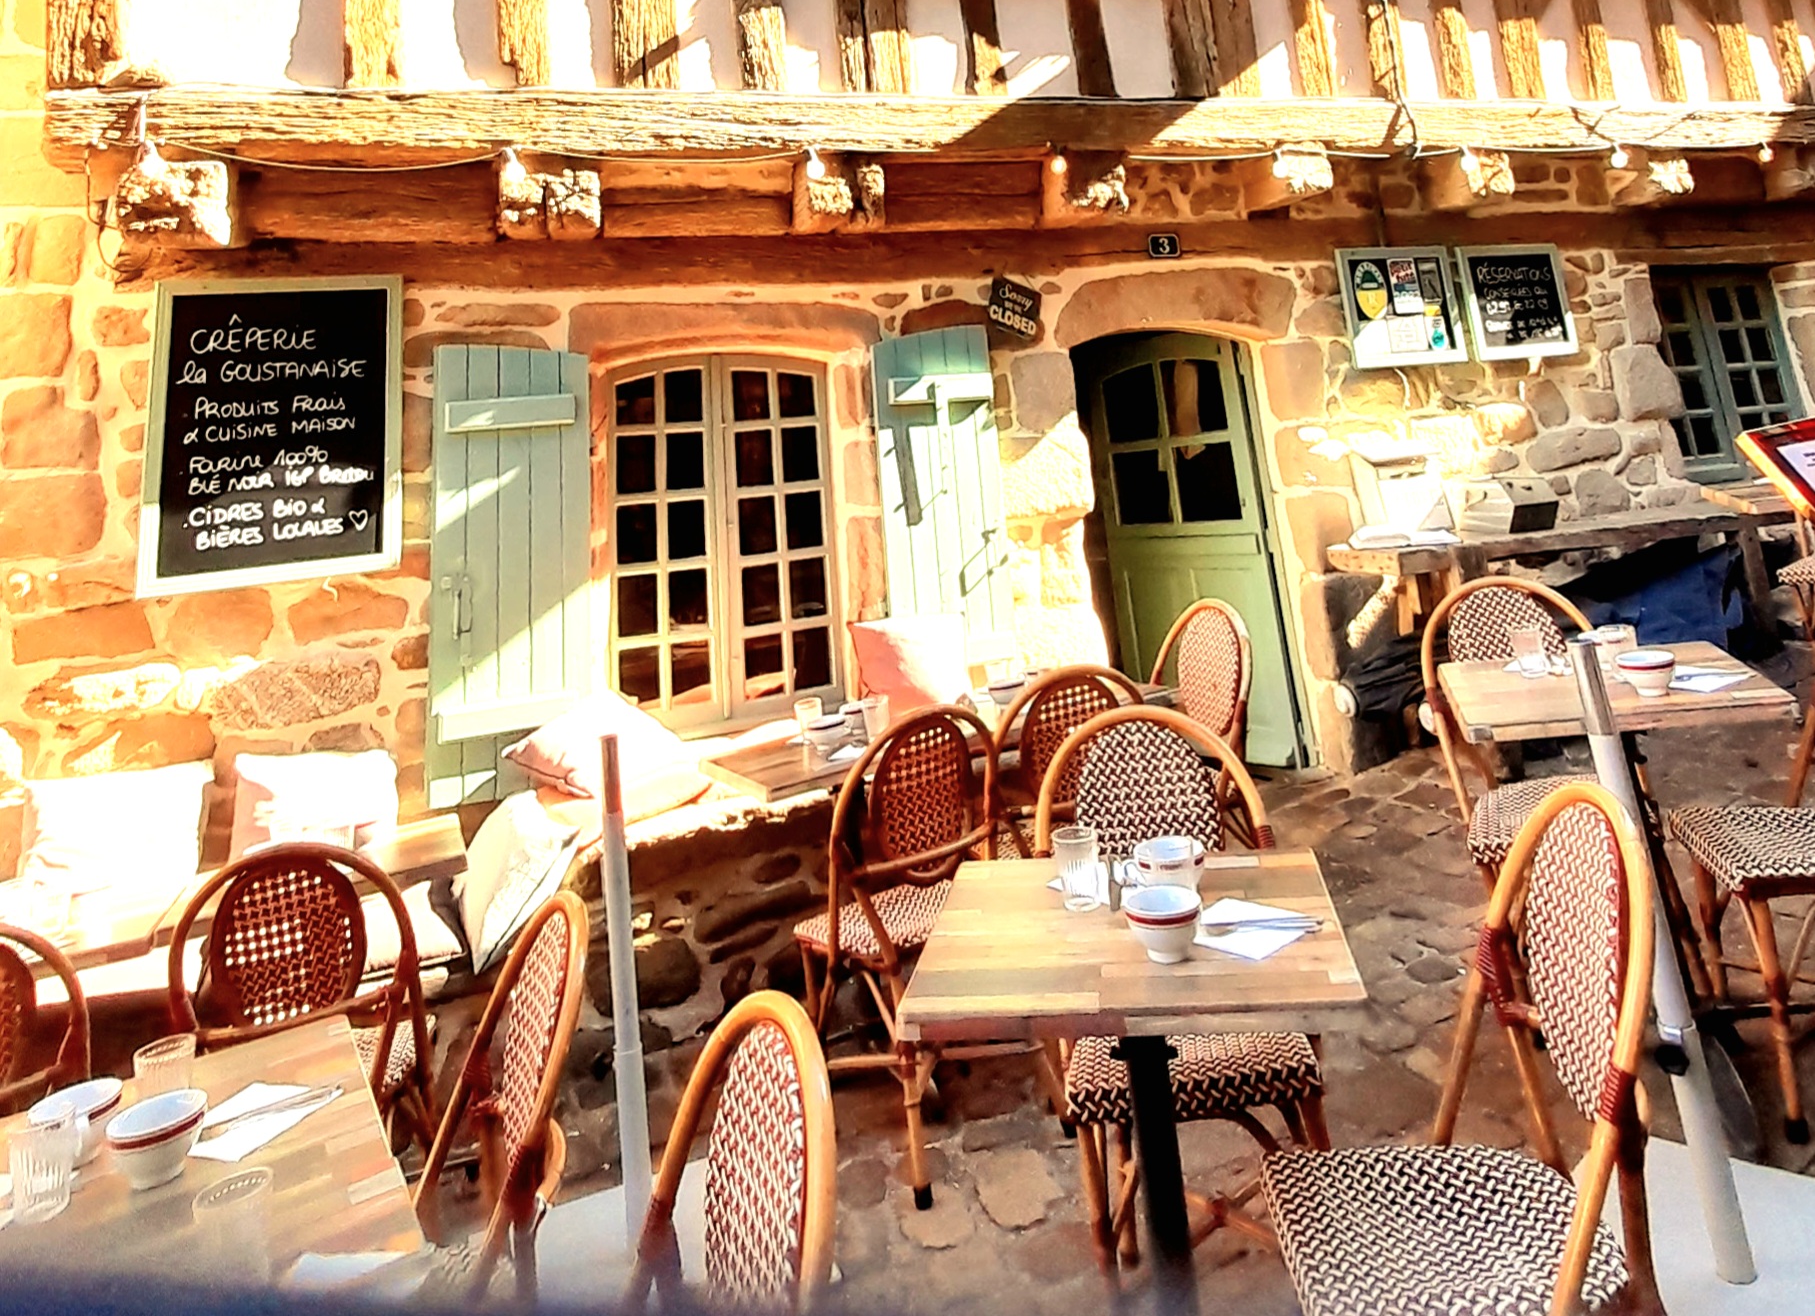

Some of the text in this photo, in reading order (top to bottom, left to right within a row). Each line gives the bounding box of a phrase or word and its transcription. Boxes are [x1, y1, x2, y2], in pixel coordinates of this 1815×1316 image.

[1158, 237, 1171, 255] 3
[999, 283, 1034, 312] Sorry
[990, 304, 1037, 335] CLOSED
[190, 313, 317, 355] CRÊPERIE
[220, 358, 368, 383] GOUSTANAISE
[194, 396, 280, 420] PRODUITS
[205, 423, 278, 443] CUISINE
[291, 416, 356, 435] MAISON
[273, 445, 329, 466] 100%
[188, 473, 222, 495] BLÉ
[188, 501, 264, 528] CIDRES
[272, 497, 308, 519] BIO
[195, 517, 344, 551] BIÈRES LOCALES
